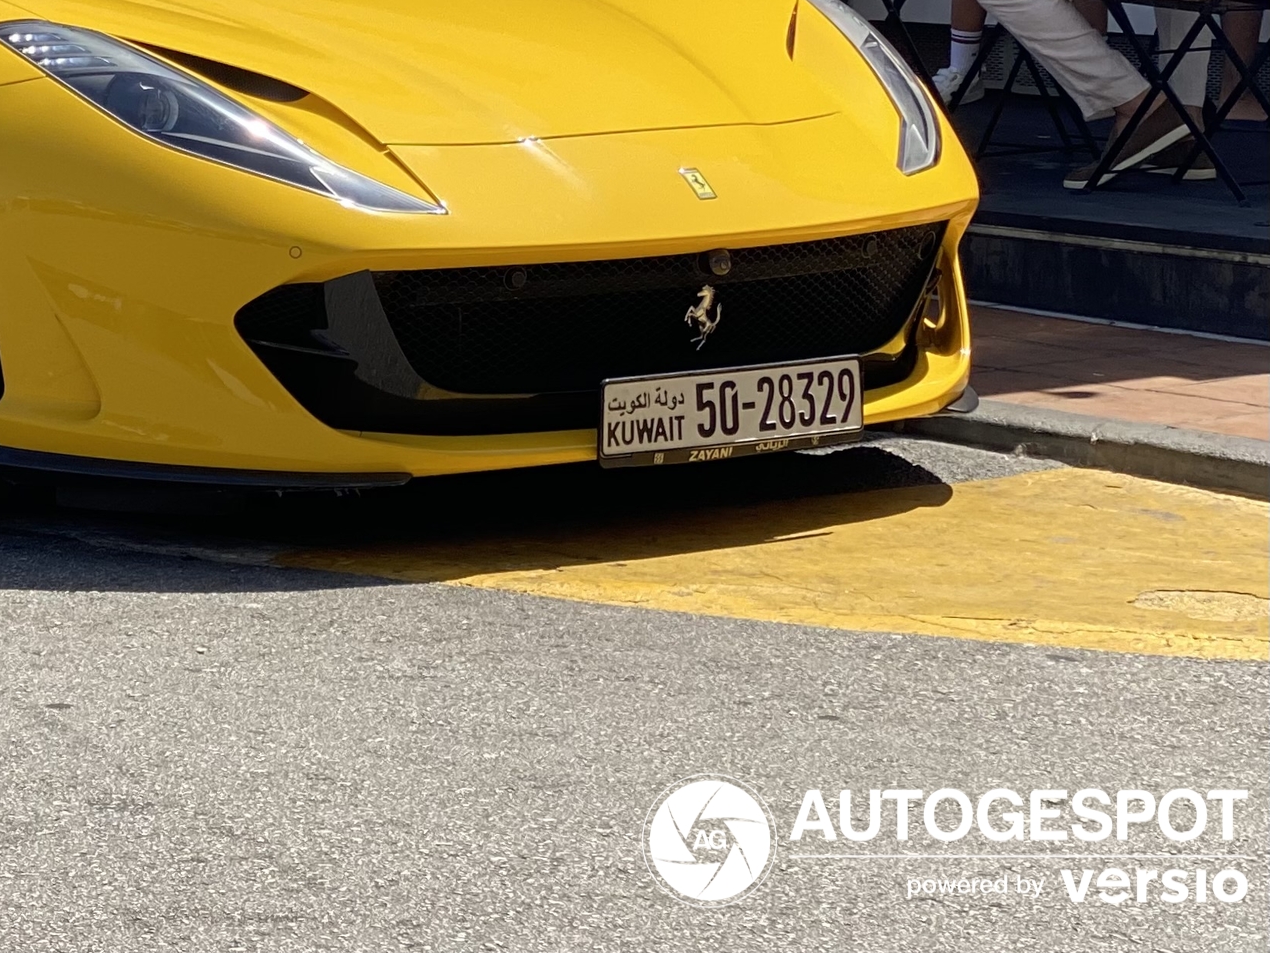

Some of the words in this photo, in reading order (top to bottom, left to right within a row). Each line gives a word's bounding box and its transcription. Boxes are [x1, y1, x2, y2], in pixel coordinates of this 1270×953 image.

[607, 391, 651, 417] الكويت
[654, 386, 685, 411] دولة
[695, 367, 855, 438] 50-28329
[606, 415, 685, 448] KUWAIT
[688, 447, 733, 463] ZAYANI
